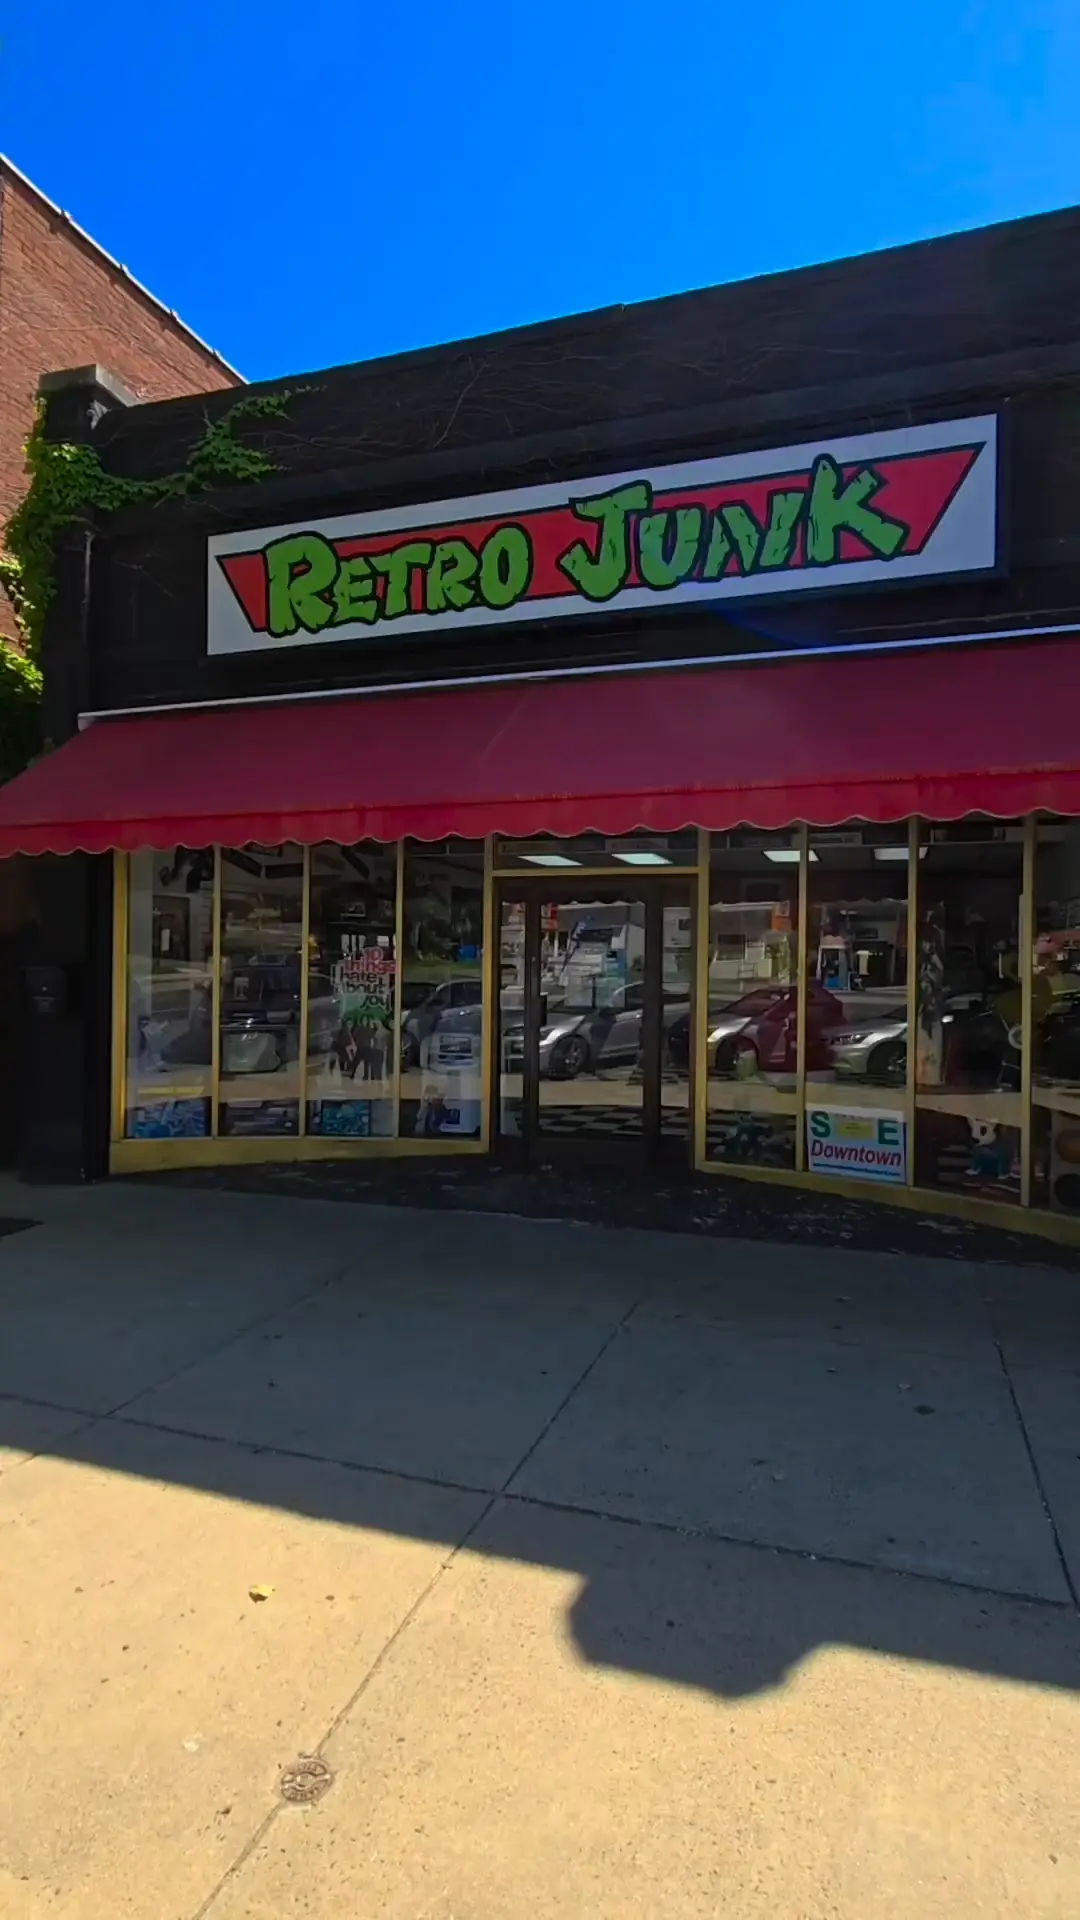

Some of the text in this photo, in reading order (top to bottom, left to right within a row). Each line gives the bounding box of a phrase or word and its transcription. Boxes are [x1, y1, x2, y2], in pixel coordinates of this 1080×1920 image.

[264, 455, 908, 637] RETRO JUNK
[341, 966, 378, 983] hate
[335, 979, 386, 994] about
[360, 995, 391, 1013] you
[811, 1140, 902, 1167] Downtown
